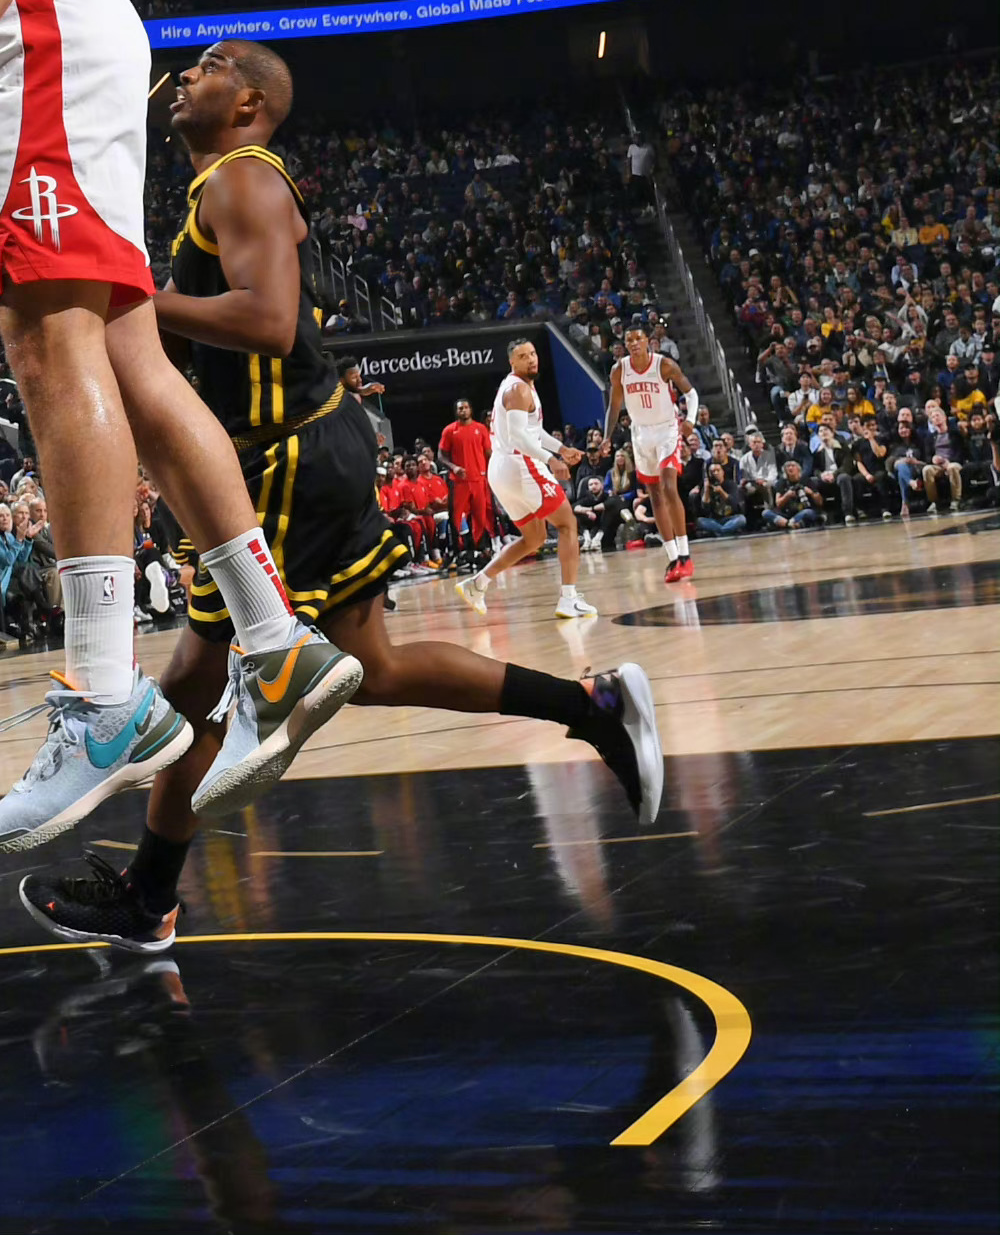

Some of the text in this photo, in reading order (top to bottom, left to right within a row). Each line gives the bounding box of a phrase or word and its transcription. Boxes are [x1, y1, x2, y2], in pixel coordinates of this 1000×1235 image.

[161, 26, 192, 39] Hire
[197, 20, 274, 38] Anywhere.
[279, 17, 317, 30] Grow
[322, 9, 412, 27] Everywhere.
[416, 0, 465, 18] Global
[356, 347, 494, 376] Mercedes-Benz
[625, 381, 660, 394] ROCKETS
[640, 394, 653, 409] 10
